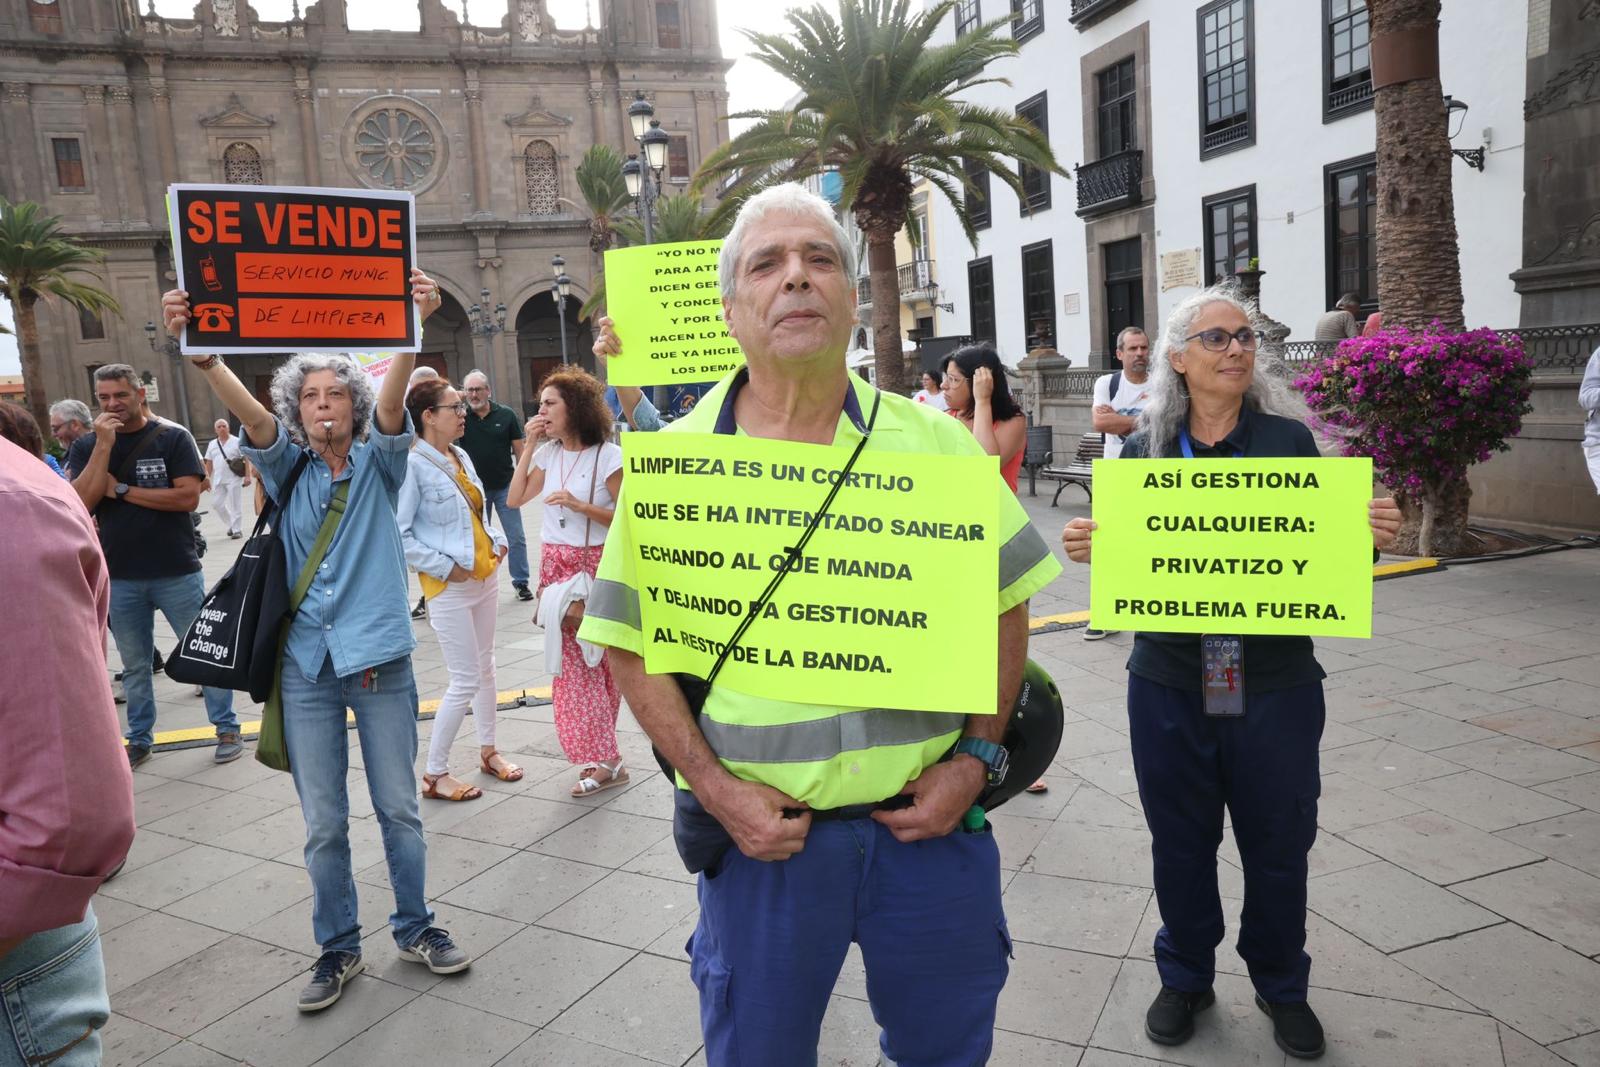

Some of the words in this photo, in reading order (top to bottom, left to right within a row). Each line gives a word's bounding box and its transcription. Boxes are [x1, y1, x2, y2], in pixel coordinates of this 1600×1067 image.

[188, 201, 242, 244] SE
[255, 202, 403, 249] VENDE
[686, 248, 706, 256] NO
[244, 265, 333, 280] SERVICIO
[655, 266, 691, 276] PARA
[650, 283, 690, 293] DICEN
[661, 301, 669, 309] Y
[255, 305, 283, 323] DE
[291, 309, 386, 326] LIMPIEZA
[684, 315, 710, 324] POR
[650, 333, 695, 343] HACEN
[700, 331, 716, 340] LO
[650, 351, 677, 360] QUE
[682, 350, 699, 358] YA
[703, 347, 743, 356] HICIE
[672, 366, 696, 375] LOS
[630, 457, 726, 476] LIMPIEZA
[733, 460, 763, 478] ES
[771, 463, 805, 482] UN
[811, 468, 914, 492] CORTIJO
[1143, 469, 1182, 489] ASÍ
[1191, 472, 1320, 489] GESTIONA
[634, 502, 668, 520] QUE
[673, 504, 699, 521] SE
[706, 505, 739, 523] HA
[746, 507, 883, 534] INTENTADO
[890, 519, 985, 541] SANEAR
[1146, 516, 1316, 533] CUALQUIERA:
[639, 544, 725, 569] ECHANDO
[731, 552, 761, 570] AL
[768, 554, 819, 574] QUE
[827, 558, 913, 581] MANDA
[1152, 557, 1283, 575] PRIVATIZO
[1292, 560, 1309, 575] Y
[201, 608, 227, 622] wear
[647, 586, 659, 602] Y
[664, 588, 743, 617] DEJANDO
[787, 603, 928, 629] GESTIONAR
[1115, 599, 1247, 618] PROBLEMA
[1256, 602, 1346, 621] FUERA.
[195, 620, 213, 636] the
[190, 636, 229, 660] change
[653, 627, 678, 643] AL
[680, 631, 727, 657] RESTO
[733, 645, 759, 664] DE
[765, 649, 795, 668] LA
[802, 651, 892, 673] BANDA.
